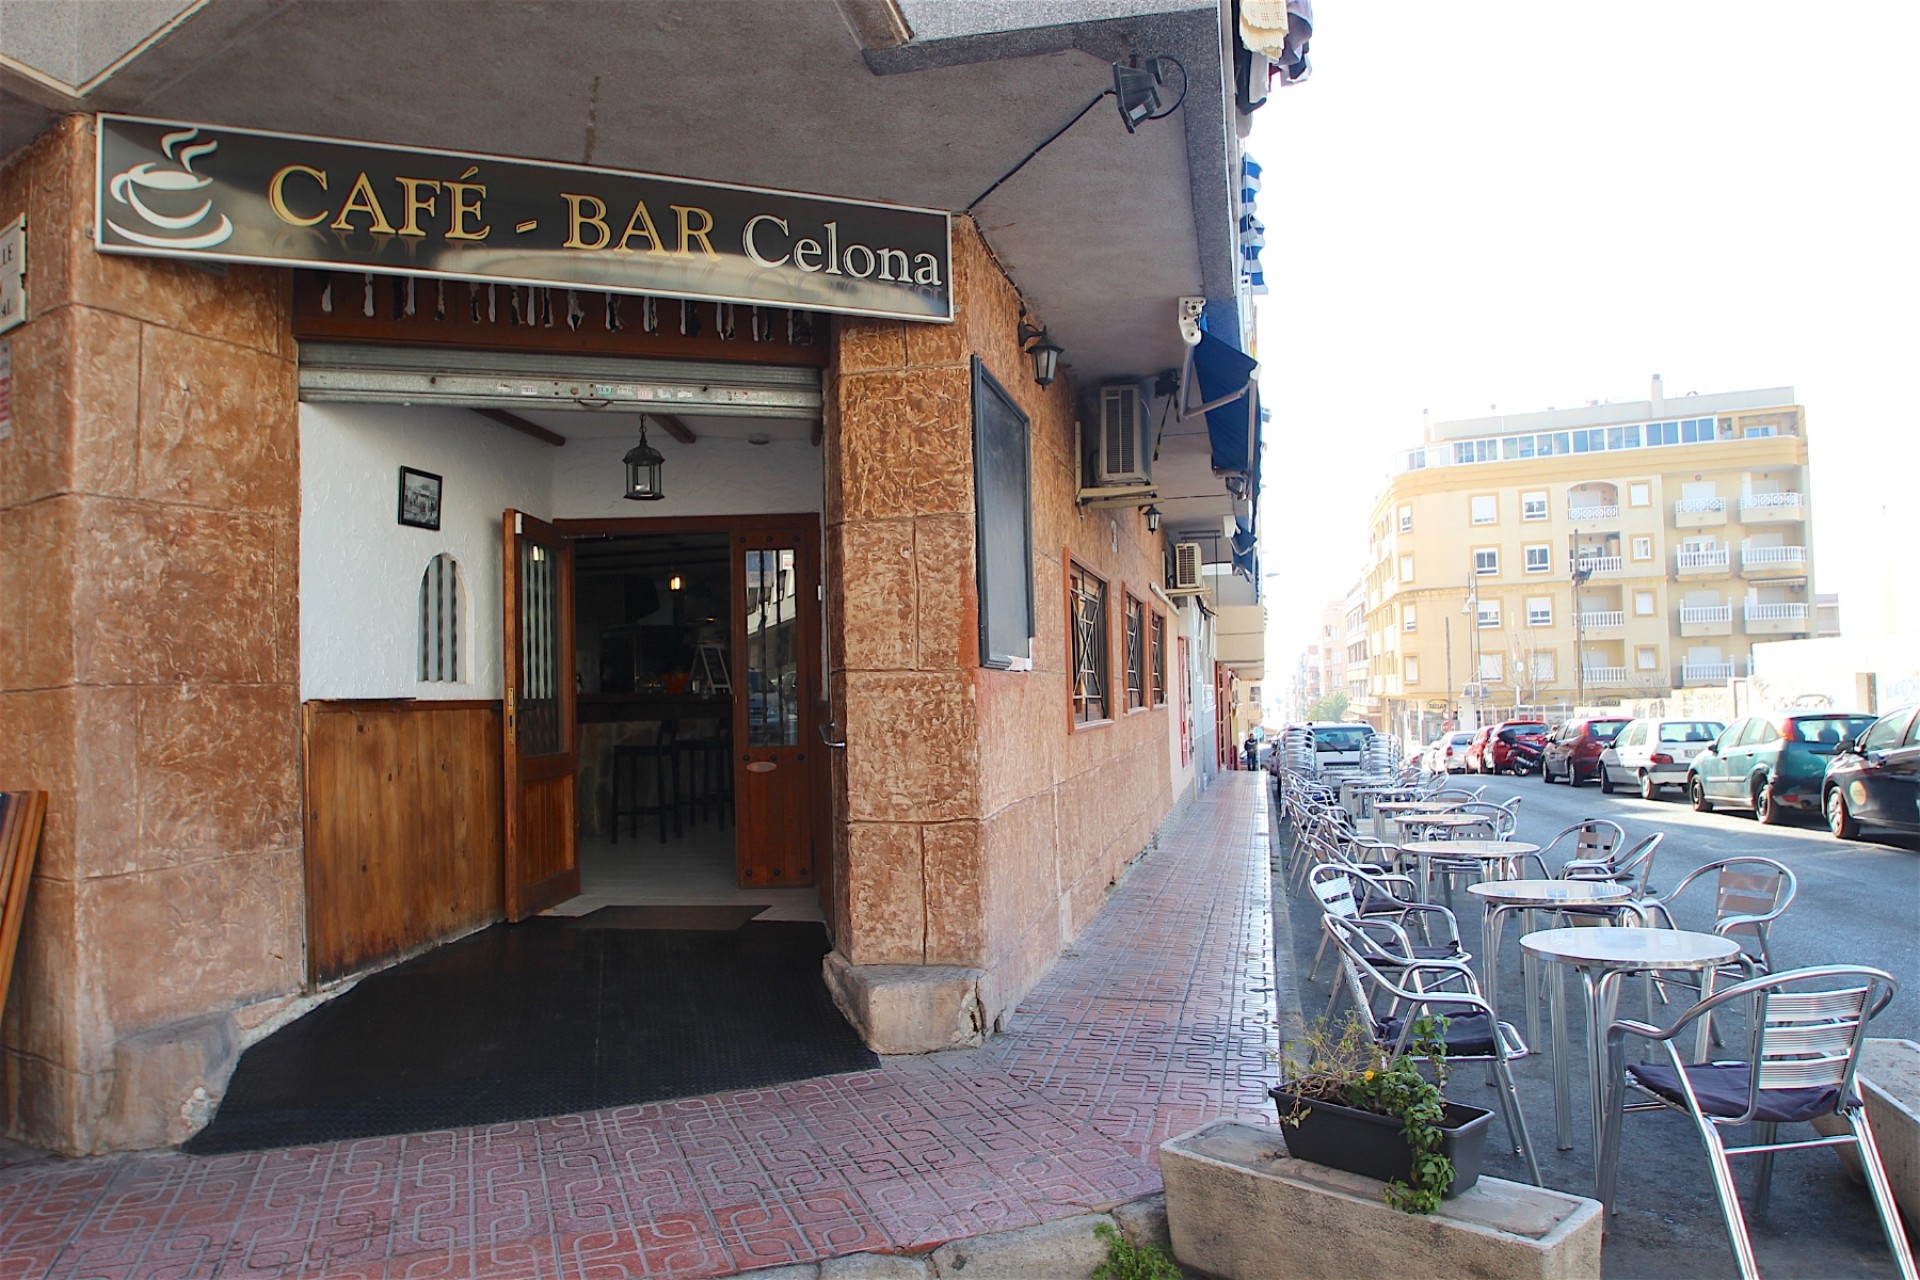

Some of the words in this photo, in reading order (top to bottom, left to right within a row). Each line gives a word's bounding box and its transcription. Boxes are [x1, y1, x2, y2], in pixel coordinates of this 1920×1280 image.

[268, 164, 491, 241] CAFÉ
[515, 219, 538, 235] -
[560, 192, 723, 262] BAR
[741, 213, 943, 286] Celona
